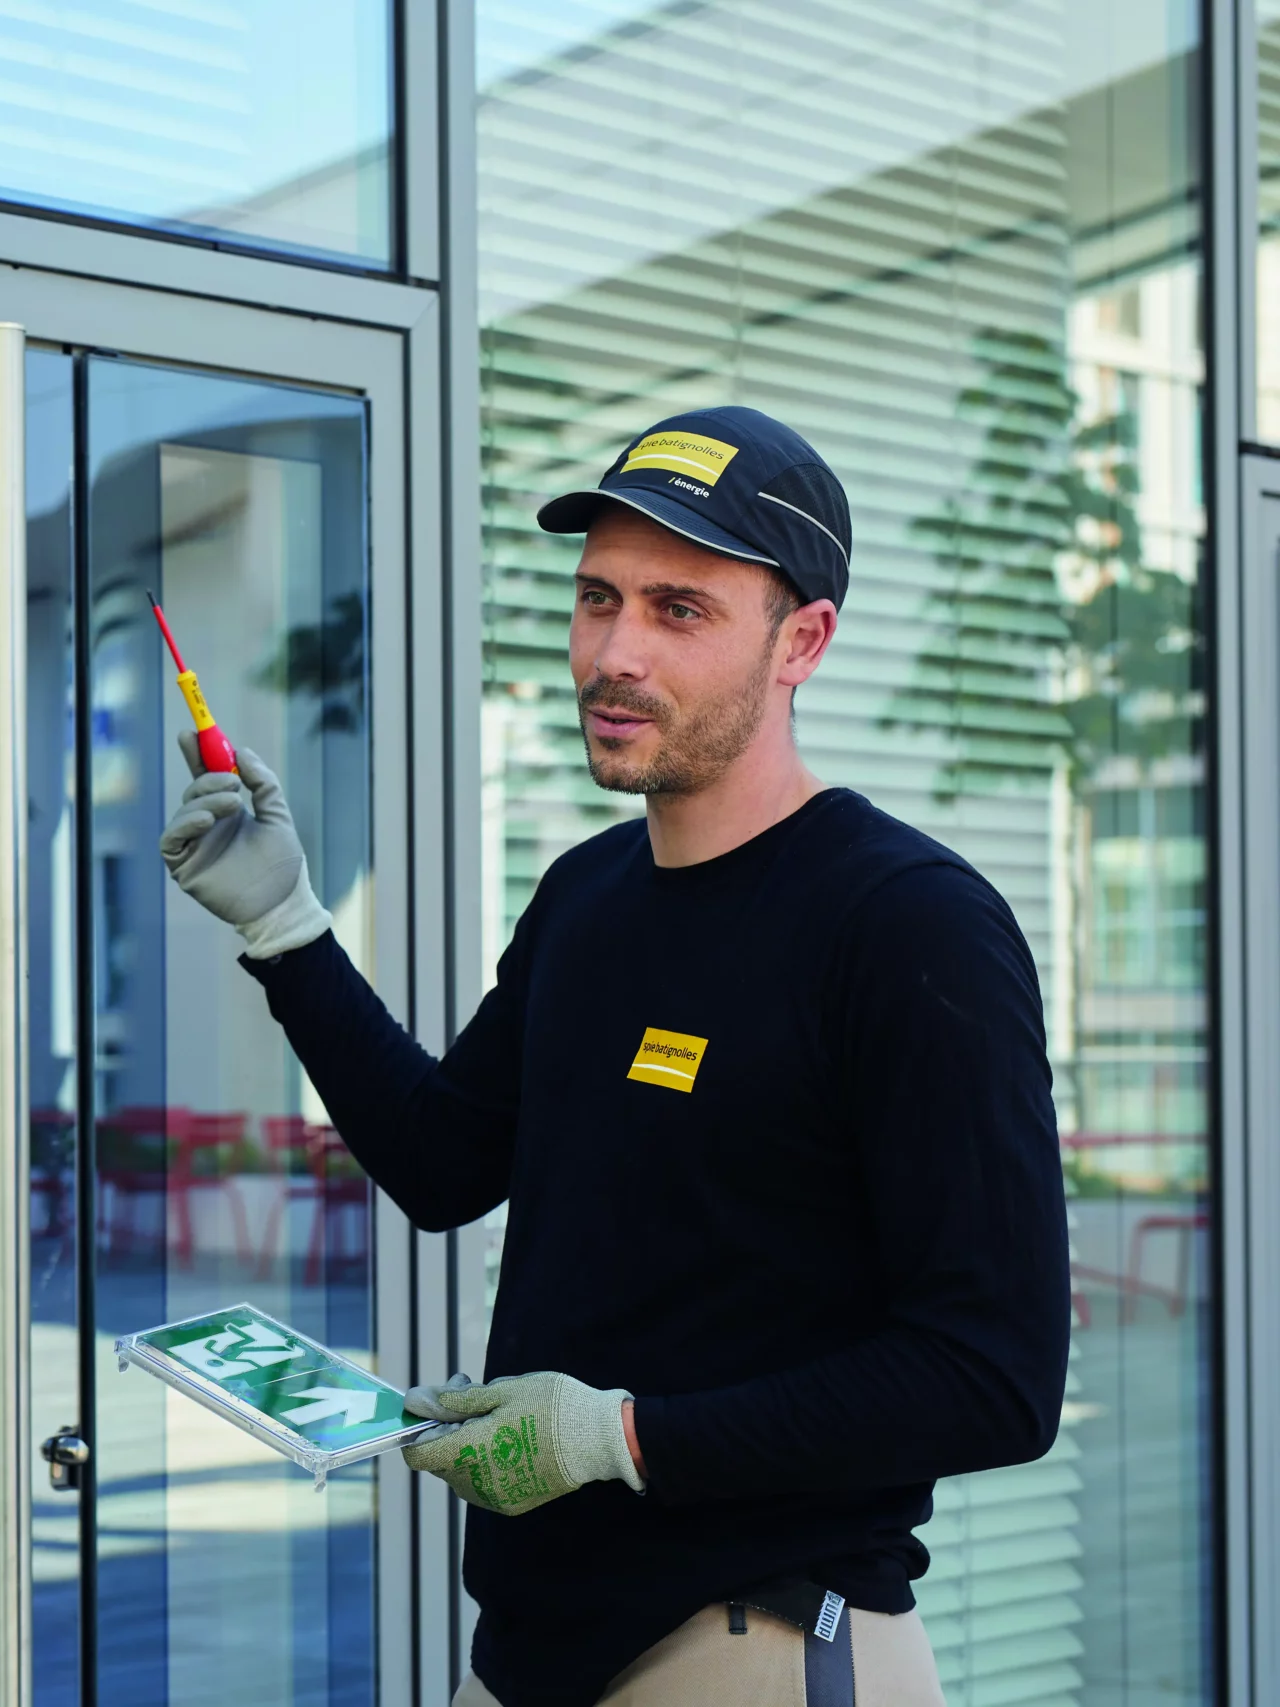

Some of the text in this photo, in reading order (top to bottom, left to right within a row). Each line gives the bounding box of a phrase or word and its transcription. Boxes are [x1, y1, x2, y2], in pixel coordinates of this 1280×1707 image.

[638, 438, 724, 460] pie batignolles
[655, 1042, 698, 1061] batignolles
